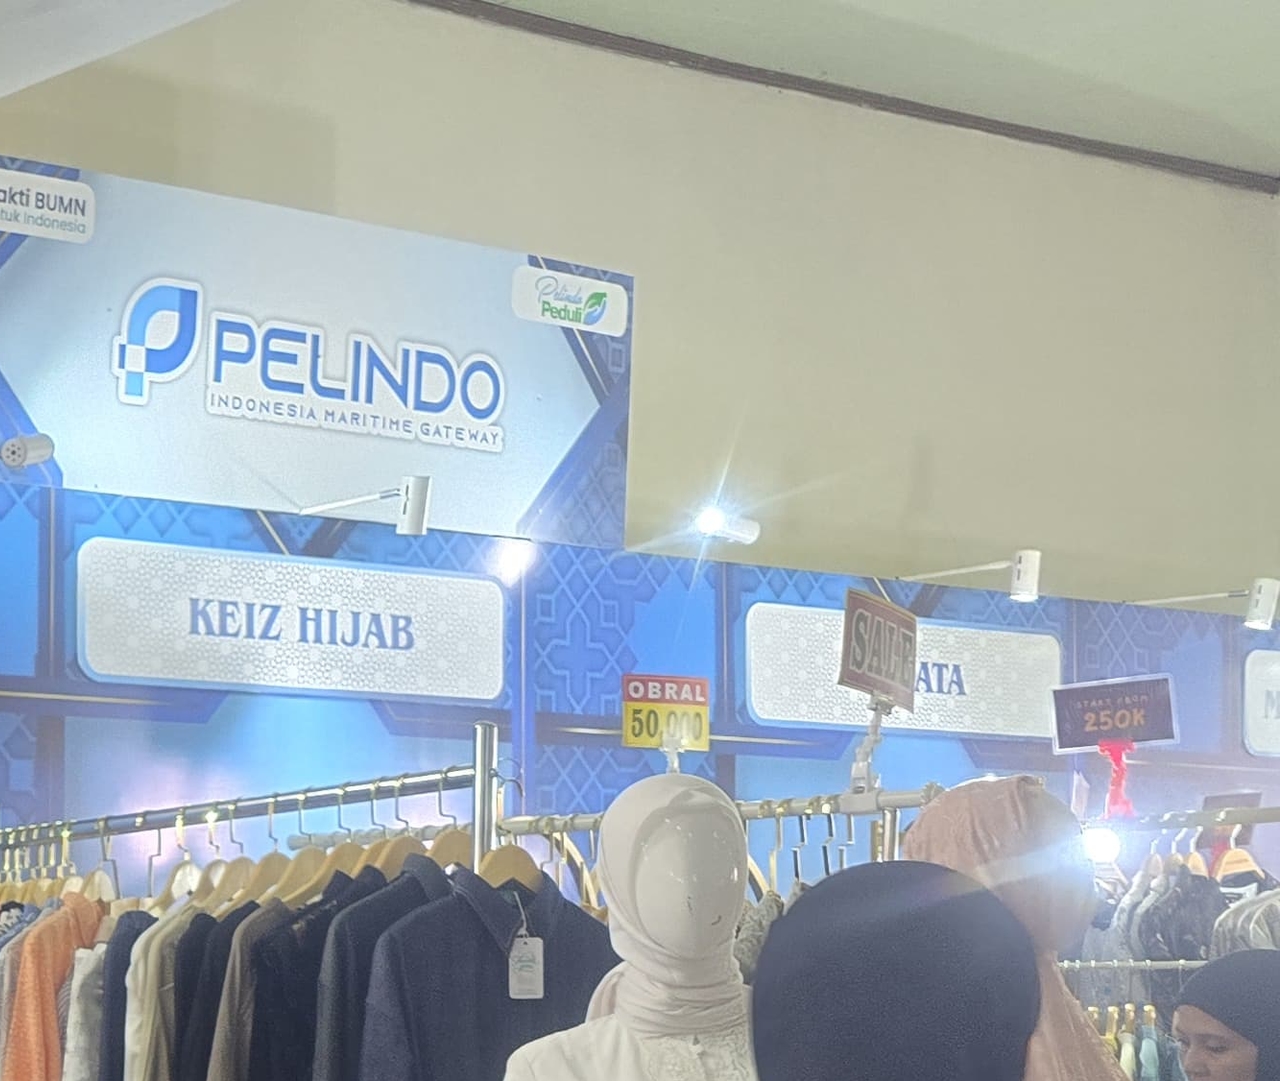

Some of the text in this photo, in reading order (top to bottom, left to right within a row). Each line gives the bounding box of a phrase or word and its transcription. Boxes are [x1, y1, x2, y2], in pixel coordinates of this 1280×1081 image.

[35, 192, 86, 217] BUMN
[24, 211, 86, 234] Indonesia
[541, 300, 582, 323] Peduli
[213, 319, 501, 421] PELINDO
[211, 392, 500, 446] INDONESIA MARITIME GATEWAY
[190, 598, 415, 650] KEIZ HIJAB
[849, 609, 914, 692] SALE
[628, 681, 706, 702] OBRAL
[1084, 708, 1145, 732] 250K
